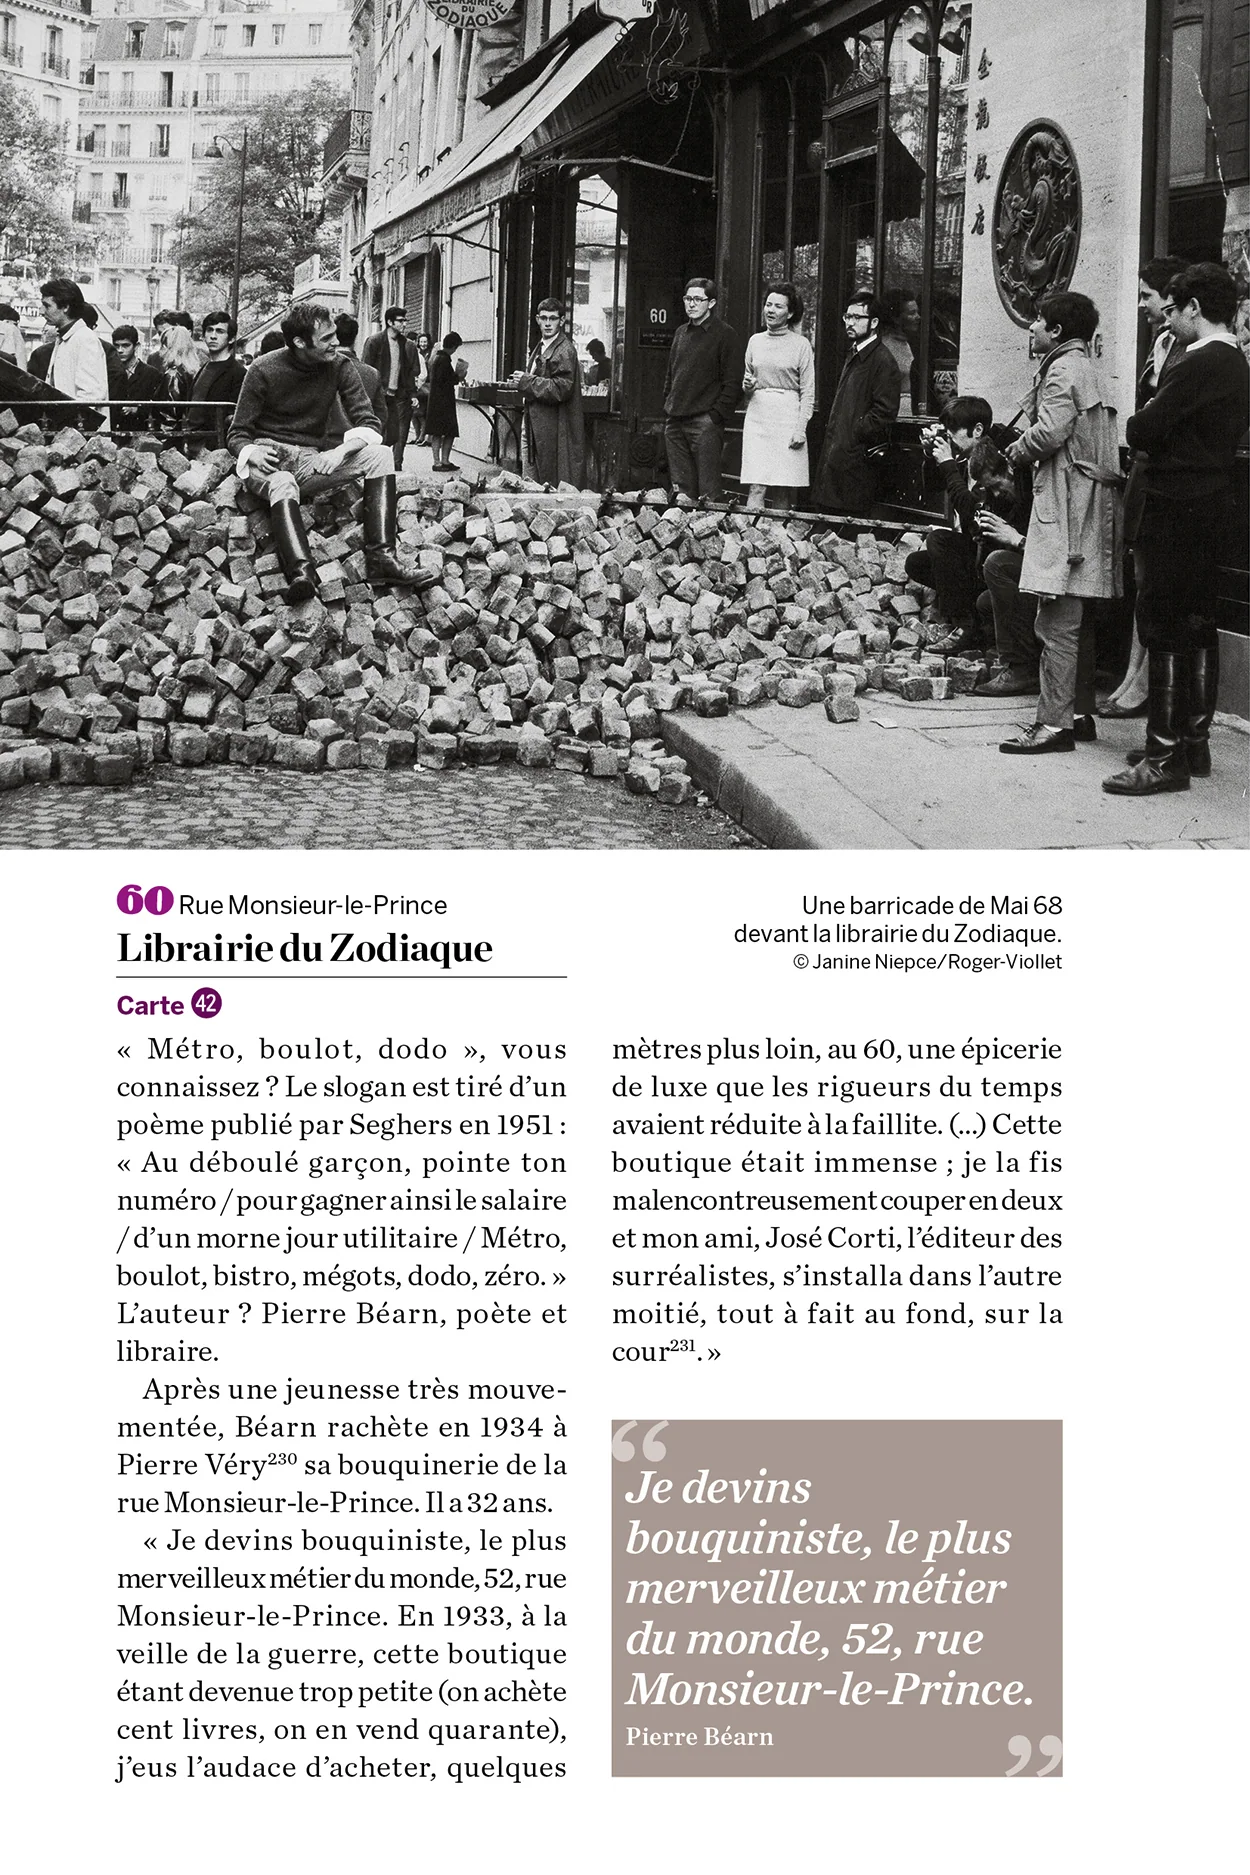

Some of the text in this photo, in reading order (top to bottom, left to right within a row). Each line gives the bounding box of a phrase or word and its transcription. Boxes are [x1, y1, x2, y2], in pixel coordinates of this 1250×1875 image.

[427, 0, 508, 28] ZODIAQUE
[461, 5, 475, 13] DU
[649, 308, 667, 324] 60
[116, 884, 447, 915] 60 Rue Monsieur-le-Prince
[803, 896, 1062, 915] Une barricade de Mai 68
[734, 924, 1061, 947] devant la librairie du Zodiaque.
[117, 932, 492, 969] Librairie du Zodiaque
[813, 954, 870, 969] Janine
[876, 954, 1062, 973] Niepce/Roger-Viollet
[117, 993, 217, 1015] Carte 42
[612, 1075, 1062, 1103] de luxe que les rigueurs du temps
[117, 1112, 203, 1141] poème
[211, 1112, 292, 1141] publié
[299, 1120, 344, 1141] par
[350, 1113, 452, 1141] Seghers
[460, 1120, 490, 1135] en
[498, 1115, 553, 1135] 1951
[611, 1151, 731, 1178] boutique
[742, 1150, 804, 1172] était
[814, 1151, 937, 1172] immense
[961, 1151, 986, 1178] je
[996, 1151, 1020, 1172] la
[1029, 1150, 1062, 1172] fis
[613, 1263, 774, 1290] surréalistes,
[909, 1264, 971, 1286] dans
[118, 1415, 567, 1441] mentée, Béarn rachète en 1934 à
[625, 1468, 811, 1503] Je devins
[626, 1519, 1012, 1562] bouquiniste, le plus
[626, 1567, 1007, 1604] merveilleux métier
[627, 1621, 983, 1661] du monde, 52, rue
[624, 1670, 1032, 1705] Monsieur-le-Prince.
[117, 1717, 566, 1745] cent livres, on en vend quarante),
[626, 1726, 773, 1745] Pierre Béarn
